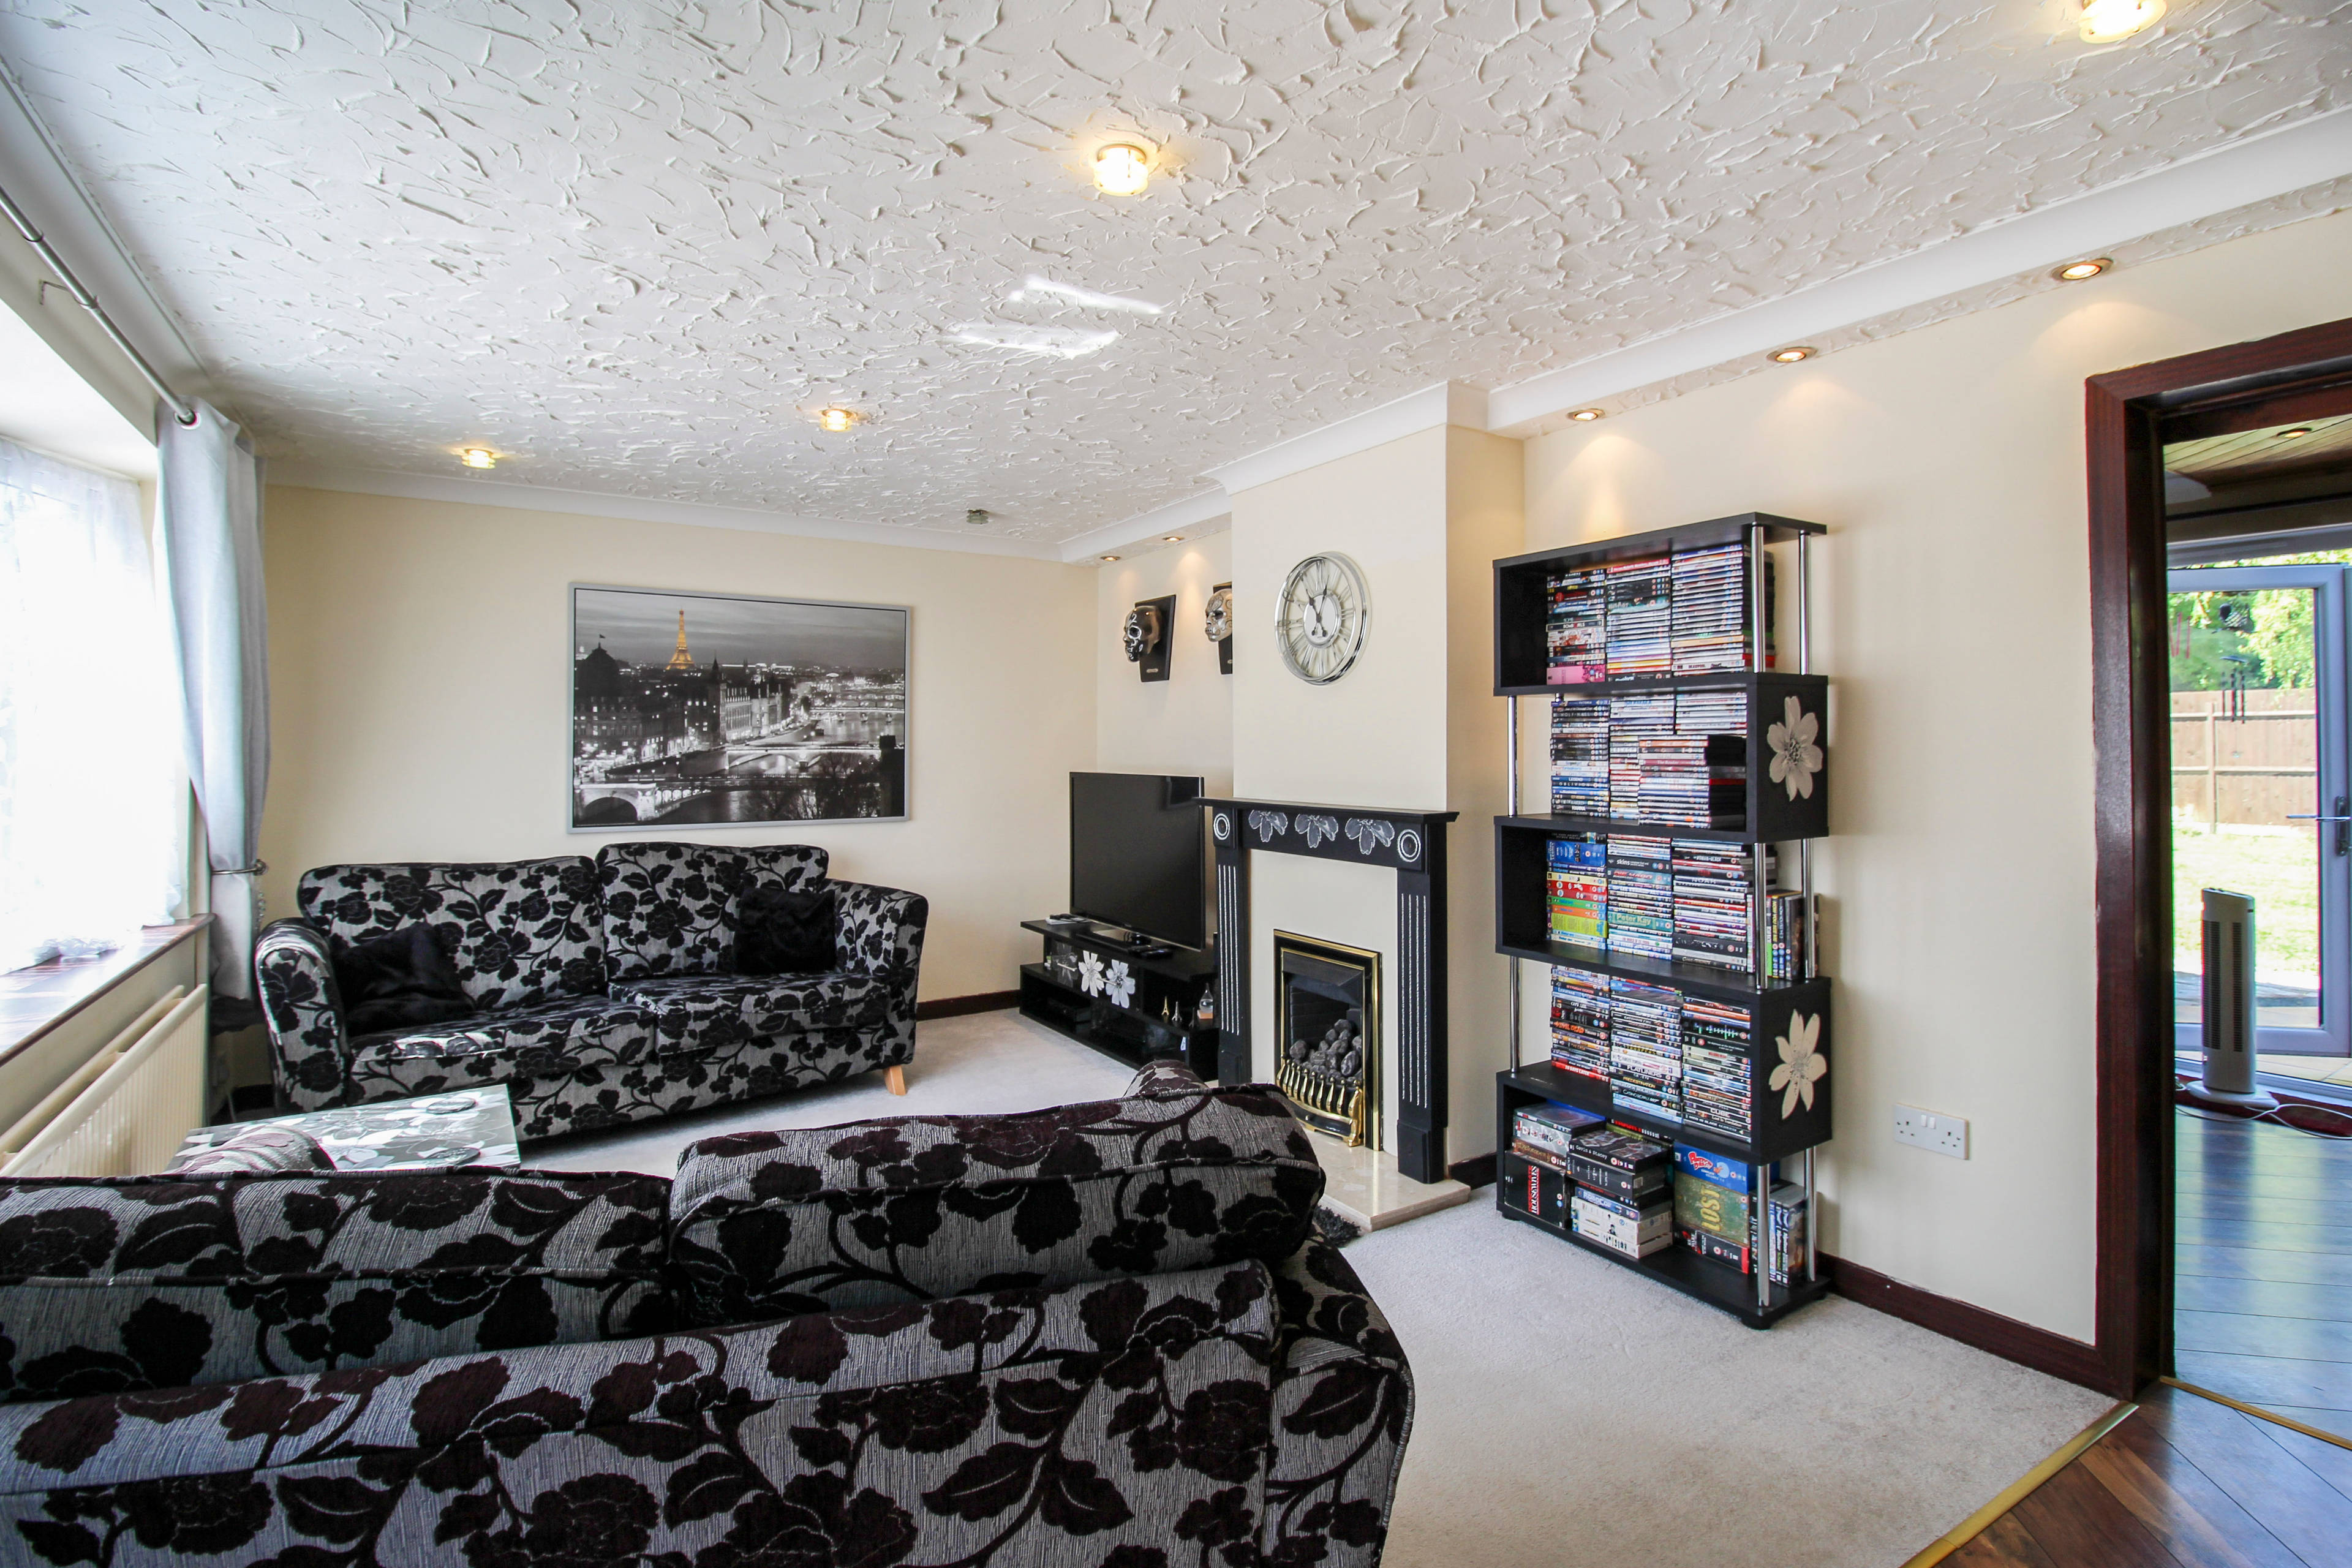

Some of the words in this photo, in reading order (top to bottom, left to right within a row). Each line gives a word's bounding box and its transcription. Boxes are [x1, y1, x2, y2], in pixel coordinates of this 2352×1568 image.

[1617, 914, 1637, 923] Peter
[1637, 916, 1652, 925] Kay
[1627, 1065, 1662, 1078] FLATLINERS
[1623, 1077, 1656, 1088] PREDESTINATION
[1710, 1107, 1730, 1118] CUBE
[1725, 1118, 1742, 1127] Translation
[1593, 1150, 1608, 1160] Stacey
[1700, 1185, 1721, 1232] LOST
